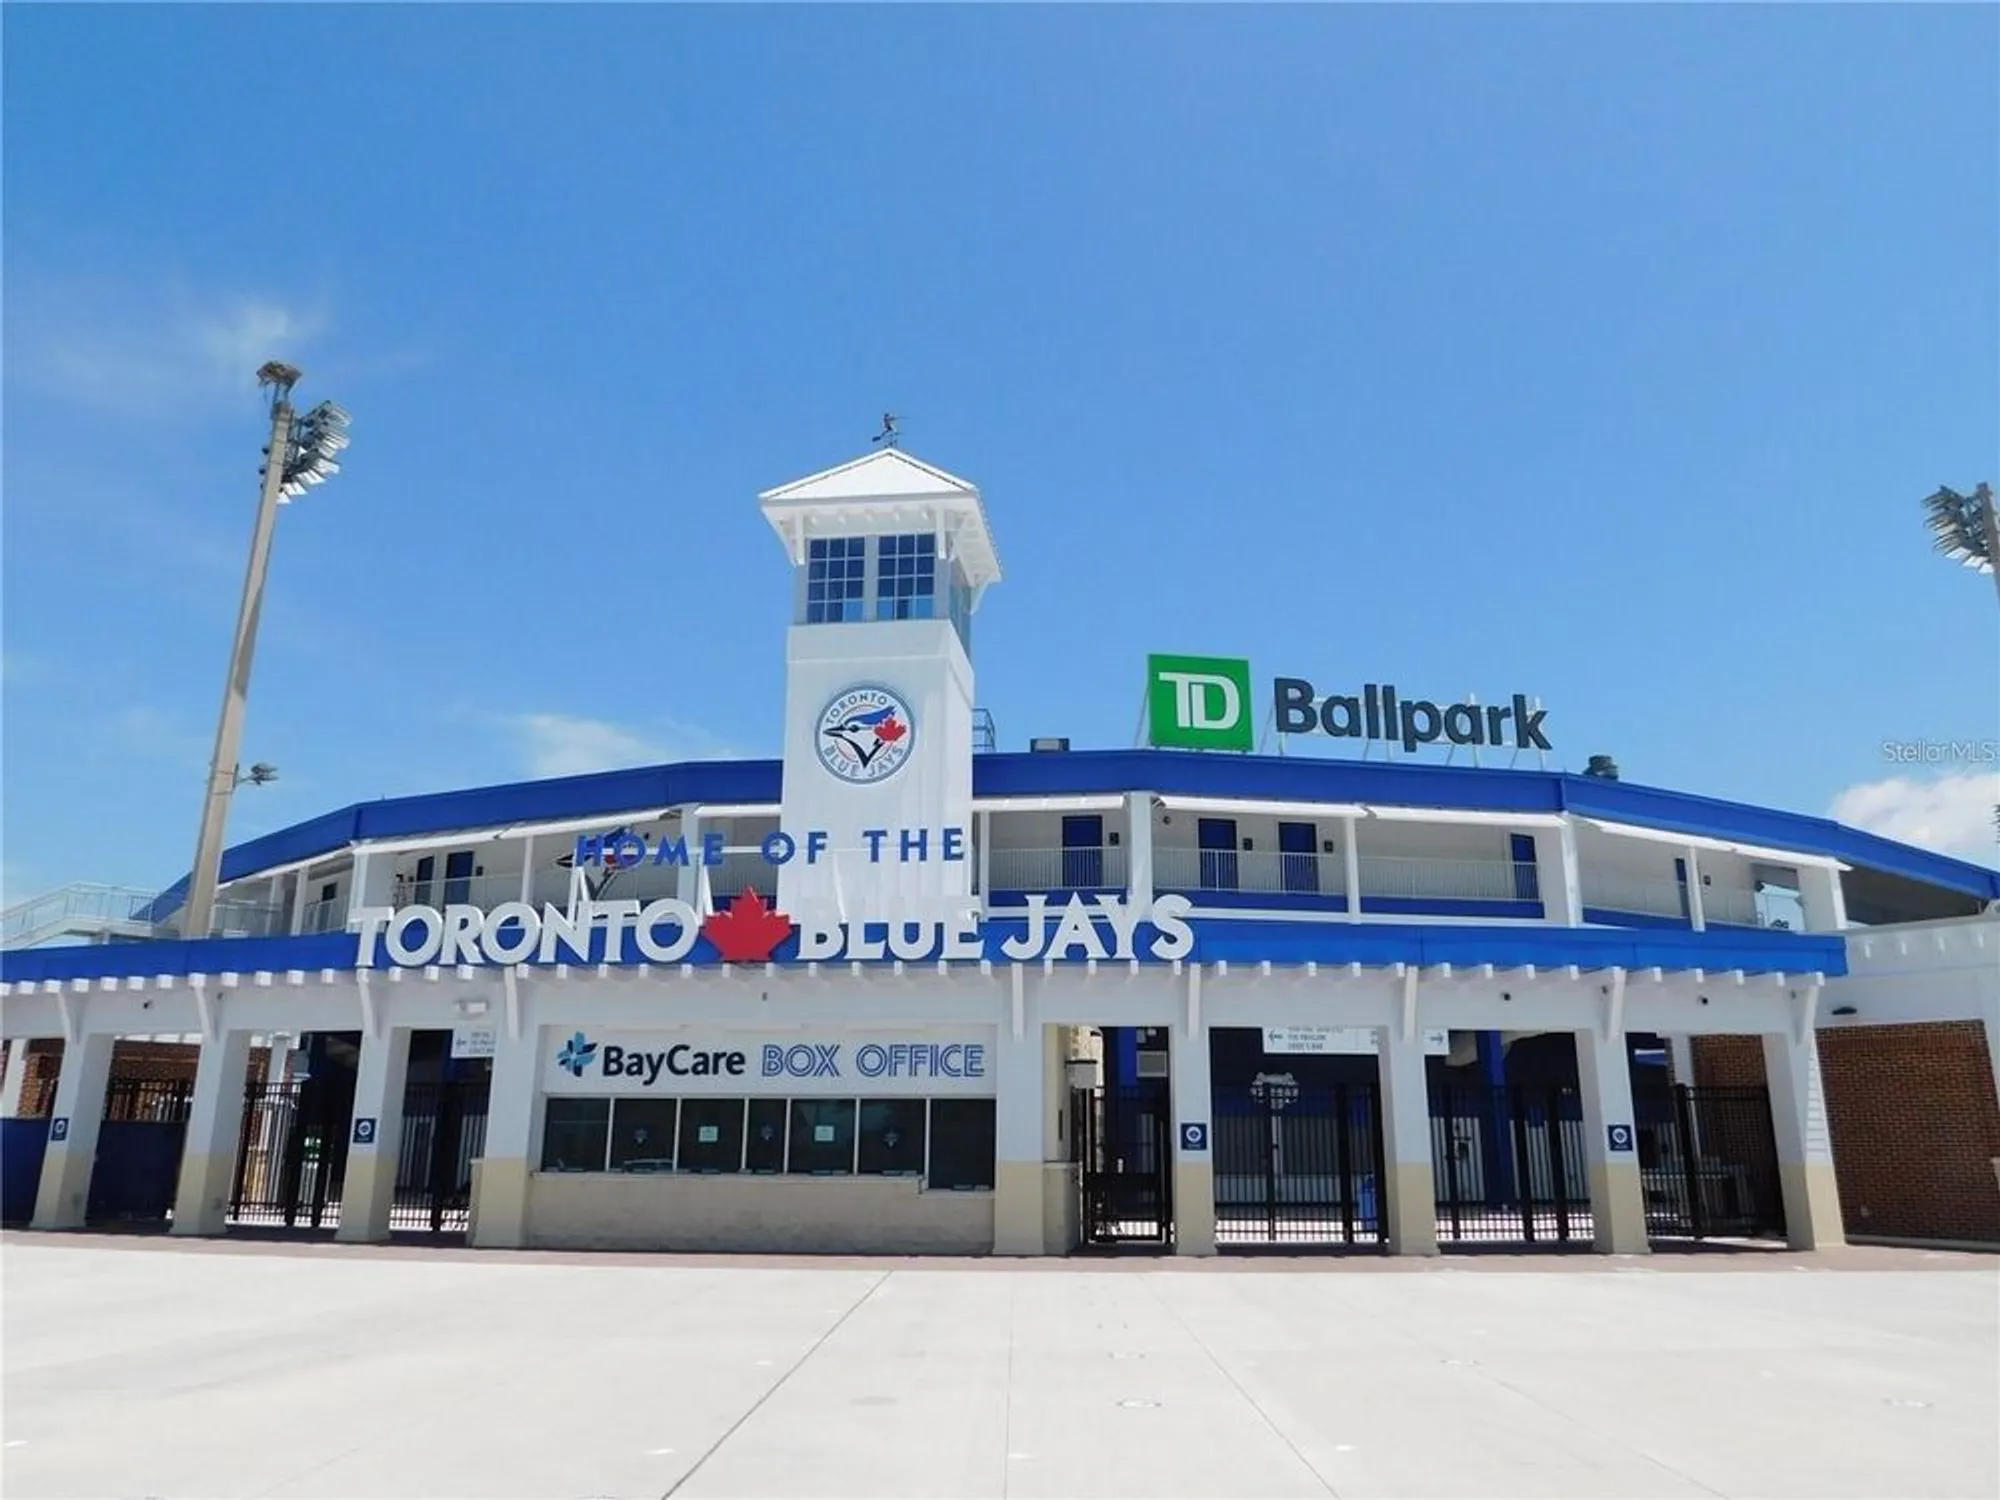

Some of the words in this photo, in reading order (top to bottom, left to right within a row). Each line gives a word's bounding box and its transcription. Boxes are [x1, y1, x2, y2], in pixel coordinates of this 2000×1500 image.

[826, 692, 888, 724] TORONTO
[1158, 671, 1241, 730] TD
[1274, 677, 1552, 753] Ballpark
[823, 744, 858, 777] BLUE
[867, 745, 904, 777] JAYS
[575, 831, 725, 870] HOME
[761, 830, 828, 866] OF
[862, 828, 966, 863] THE
[349, 897, 699, 967] TORONTO
[796, 895, 985, 961] BLUE
[1001, 891, 1194, 961] JAYS
[602, 1043, 746, 1086] BayCare
[761, 1043, 841, 1077] BOX
[856, 1043, 986, 1077] OFFICE
